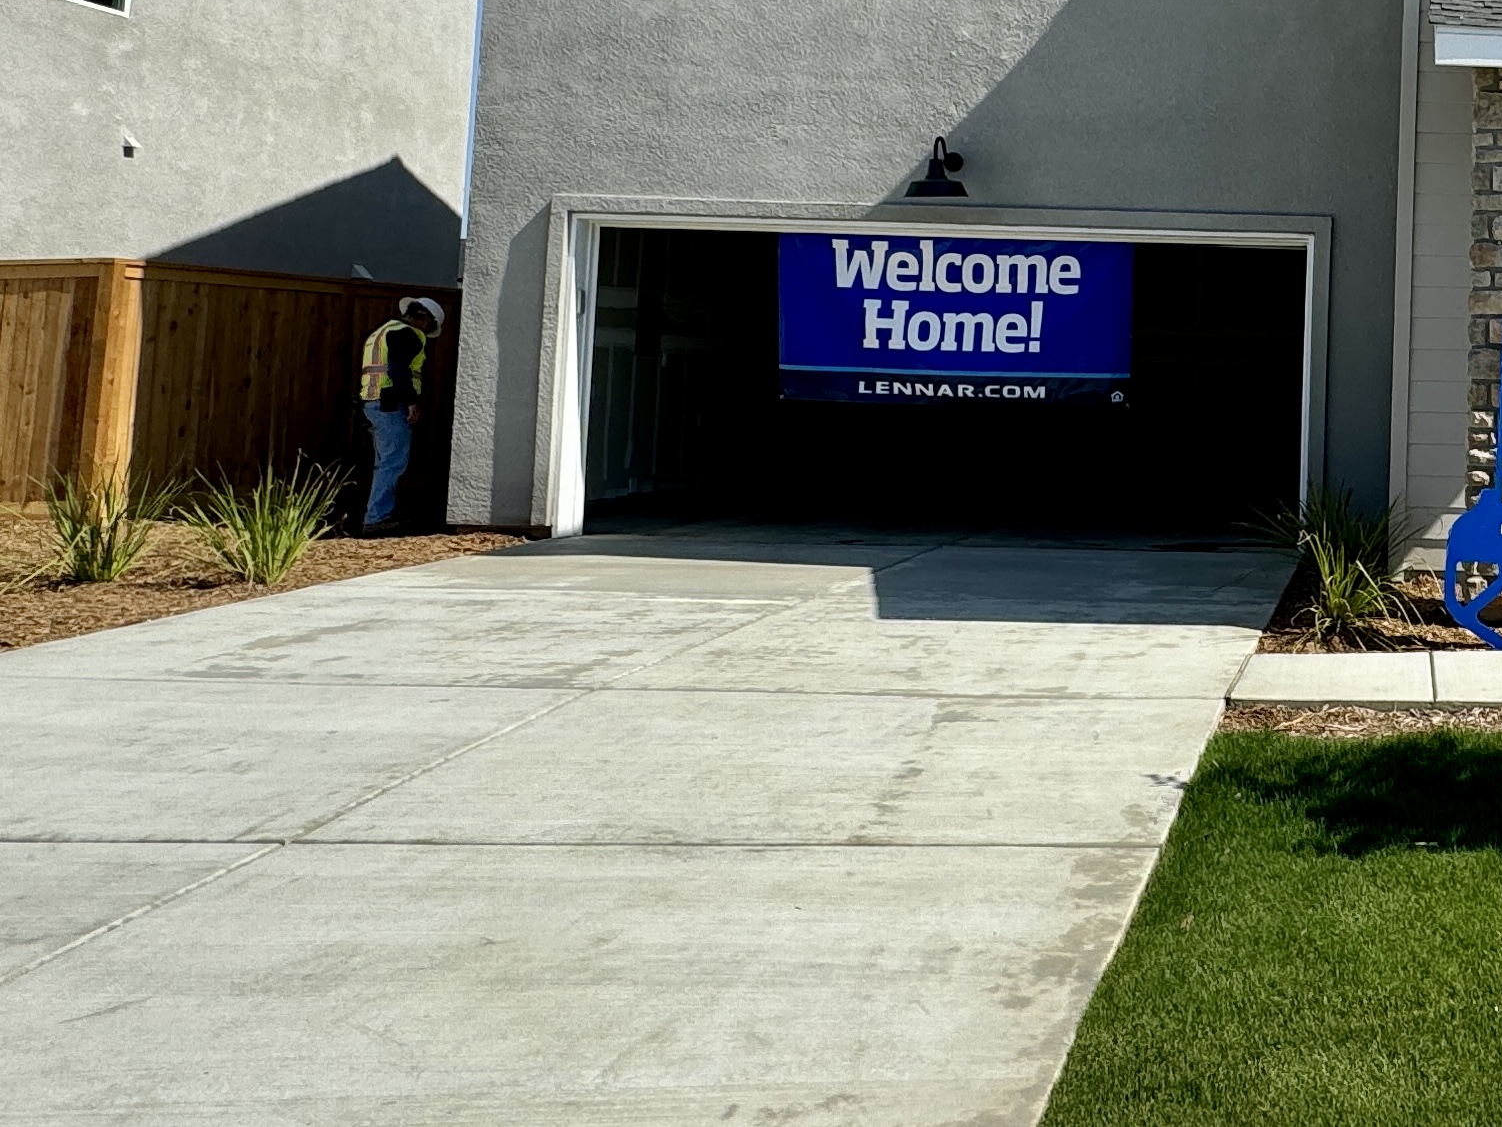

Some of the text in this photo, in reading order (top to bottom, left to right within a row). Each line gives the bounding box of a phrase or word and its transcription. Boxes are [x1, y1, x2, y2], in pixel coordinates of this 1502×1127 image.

[832, 239, 1081, 295] Welcome
[863, 299, 1044, 353] Home!
[858, 380, 1046, 400] LENNAR.COM
